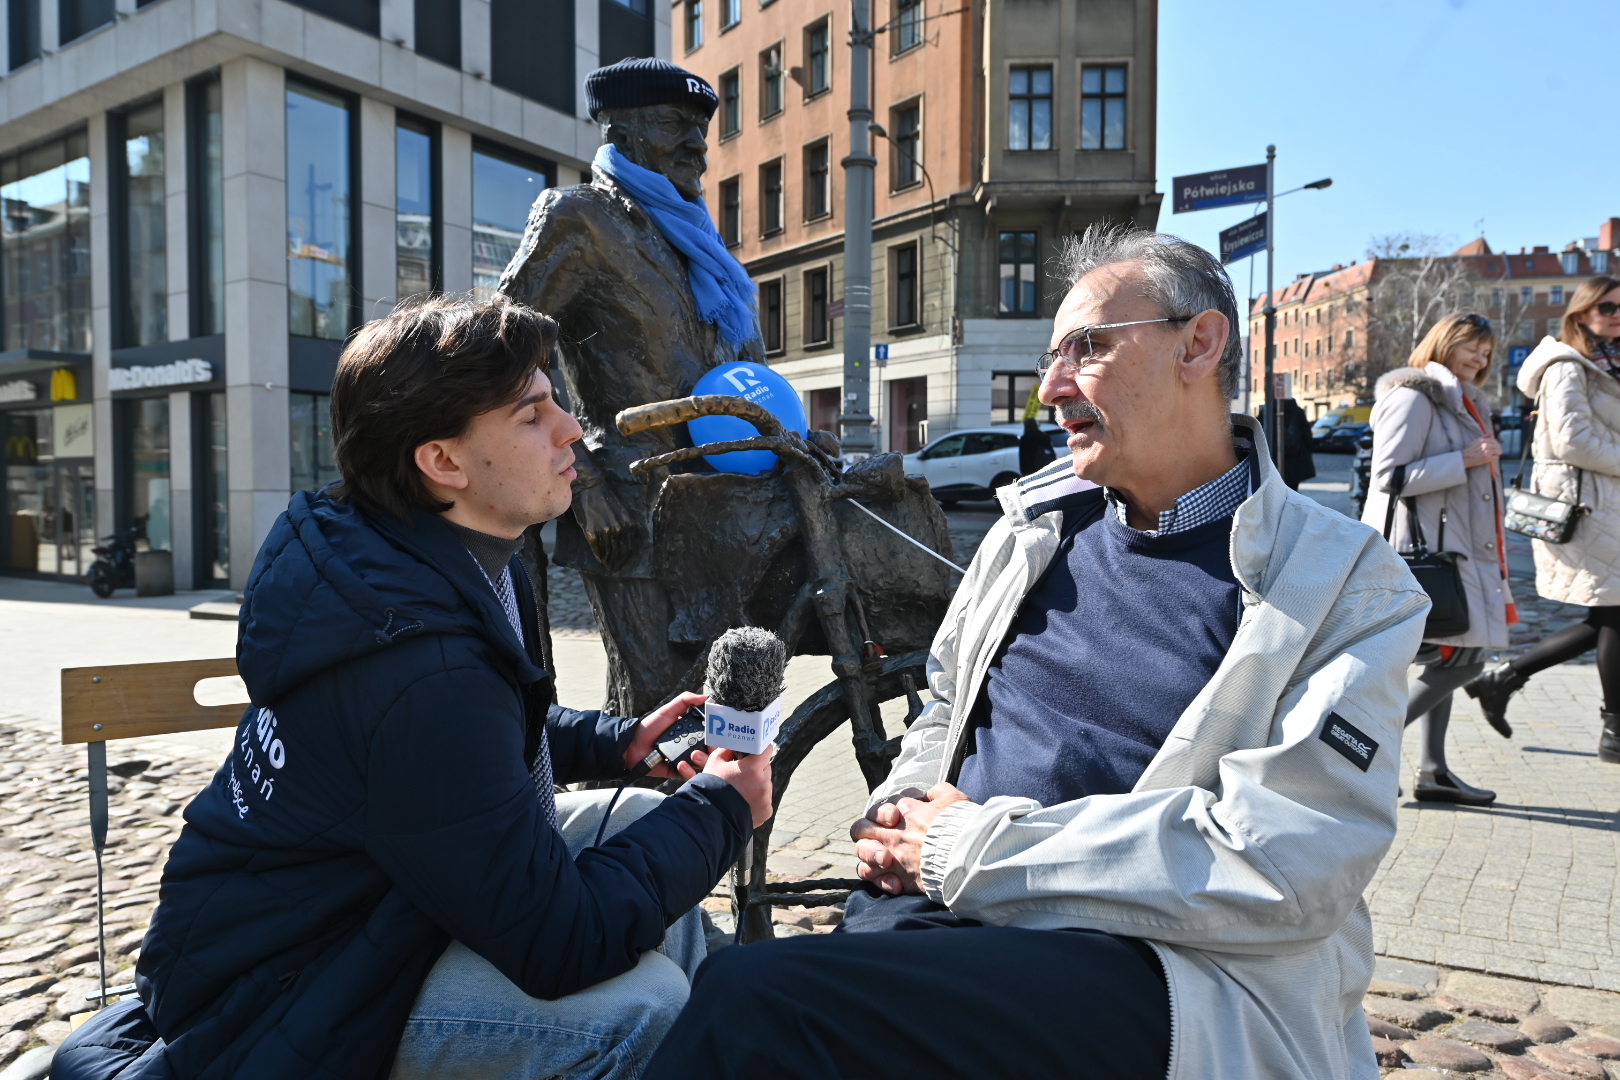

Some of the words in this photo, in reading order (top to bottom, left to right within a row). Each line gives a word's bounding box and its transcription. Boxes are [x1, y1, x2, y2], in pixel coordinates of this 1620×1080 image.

[1183, 180, 1256, 200] Półwiejska
[1513, 349, 1528, 365] P
[108, 358, 214, 391] McDonald's
[743, 385, 770, 402] Radio
[753, 391, 775, 405] oznań
[257, 706, 286, 770] dio
[727, 732, 756, 743] Poznań
[728, 722, 756, 735] Radio
[1332, 724, 1358, 746] REGATTA
[1330, 730, 1345, 742] GREAT
[1343, 739, 1369, 760] OUTDOORS
[241, 722, 275, 801] oznań
